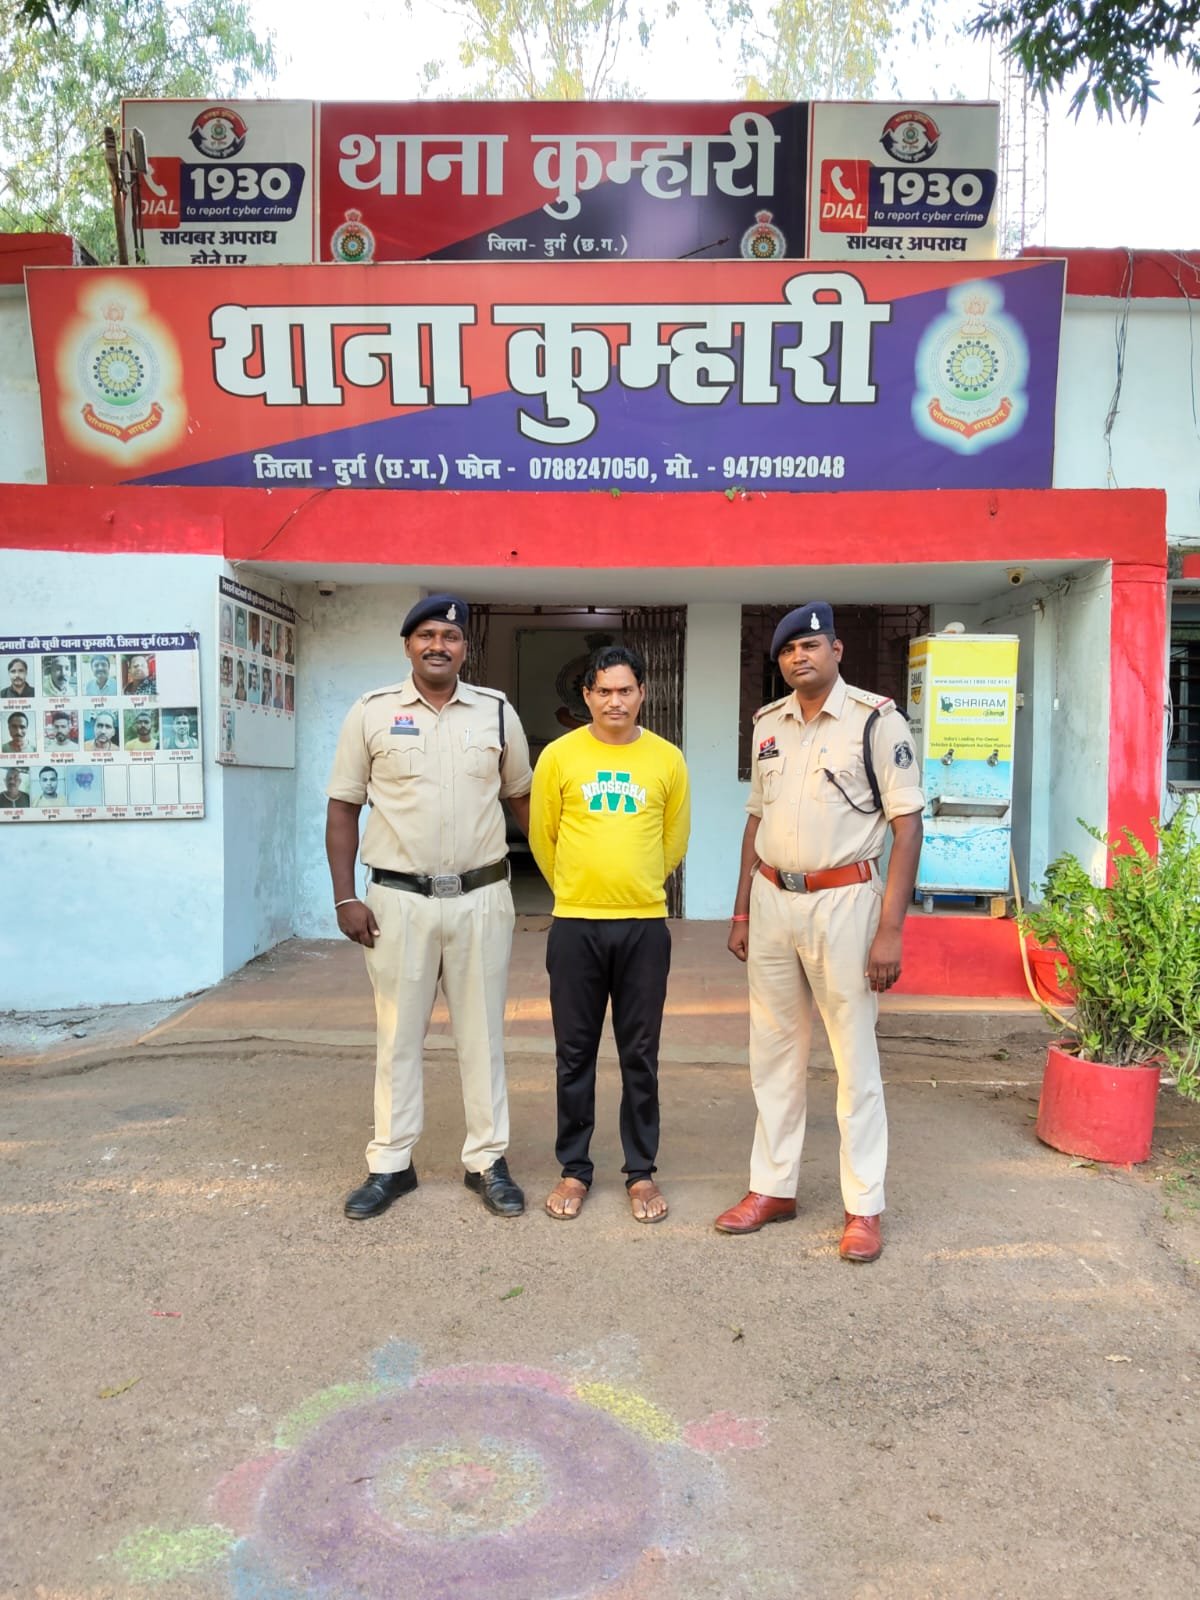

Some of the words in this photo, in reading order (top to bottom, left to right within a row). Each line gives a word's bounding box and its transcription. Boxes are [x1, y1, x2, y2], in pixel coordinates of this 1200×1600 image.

[338, 134, 508, 196] थाना
[530, 111, 781, 220] कुम्हारी
[190, 167, 291, 200] 1930
[880, 171, 983, 207] 1930
[136, 200, 179, 215] DIAL
[186, 206, 196, 215] to
[199, 206, 230, 217] report
[232, 205, 260, 217] cyber
[263, 205, 293, 215] crime
[822, 202, 866, 219] DIAL
[874, 211, 885, 220] to
[887, 211, 920, 222] report
[922, 211, 952, 223] cyber
[954, 211, 984, 222] crime
[160, 231, 215, 245] सायबर
[219, 230, 278, 245] अपराध
[544, 233, 567, 257] दुर्ग
[573, 234, 628, 256] (छ.ग.)
[846, 235, 904, 250] सायबर
[906, 236, 968, 252] अपराध
[209, 303, 478, 406] थाना
[492, 270, 892, 446] कुम्हारी
[253, 453, 313, 479] जिला
[332, 453, 367, 485] दुर्ग
[375, 454, 449, 484] (छ.ग.)
[455, 453, 501, 480] फोन
[529, 456, 658, 483] 0788247050,
[664, 453, 699, 479] मो.
[722, 455, 845, 479] 9479192048
[27, 636, 40, 648] की
[42, 636, 59, 651] सूची
[61, 639, 80, 648] थाना
[117, 635, 139, 647] जिला
[141, 634, 156, 649] दुर्ग
[954, 698, 1006, 708] SHRIRAM
